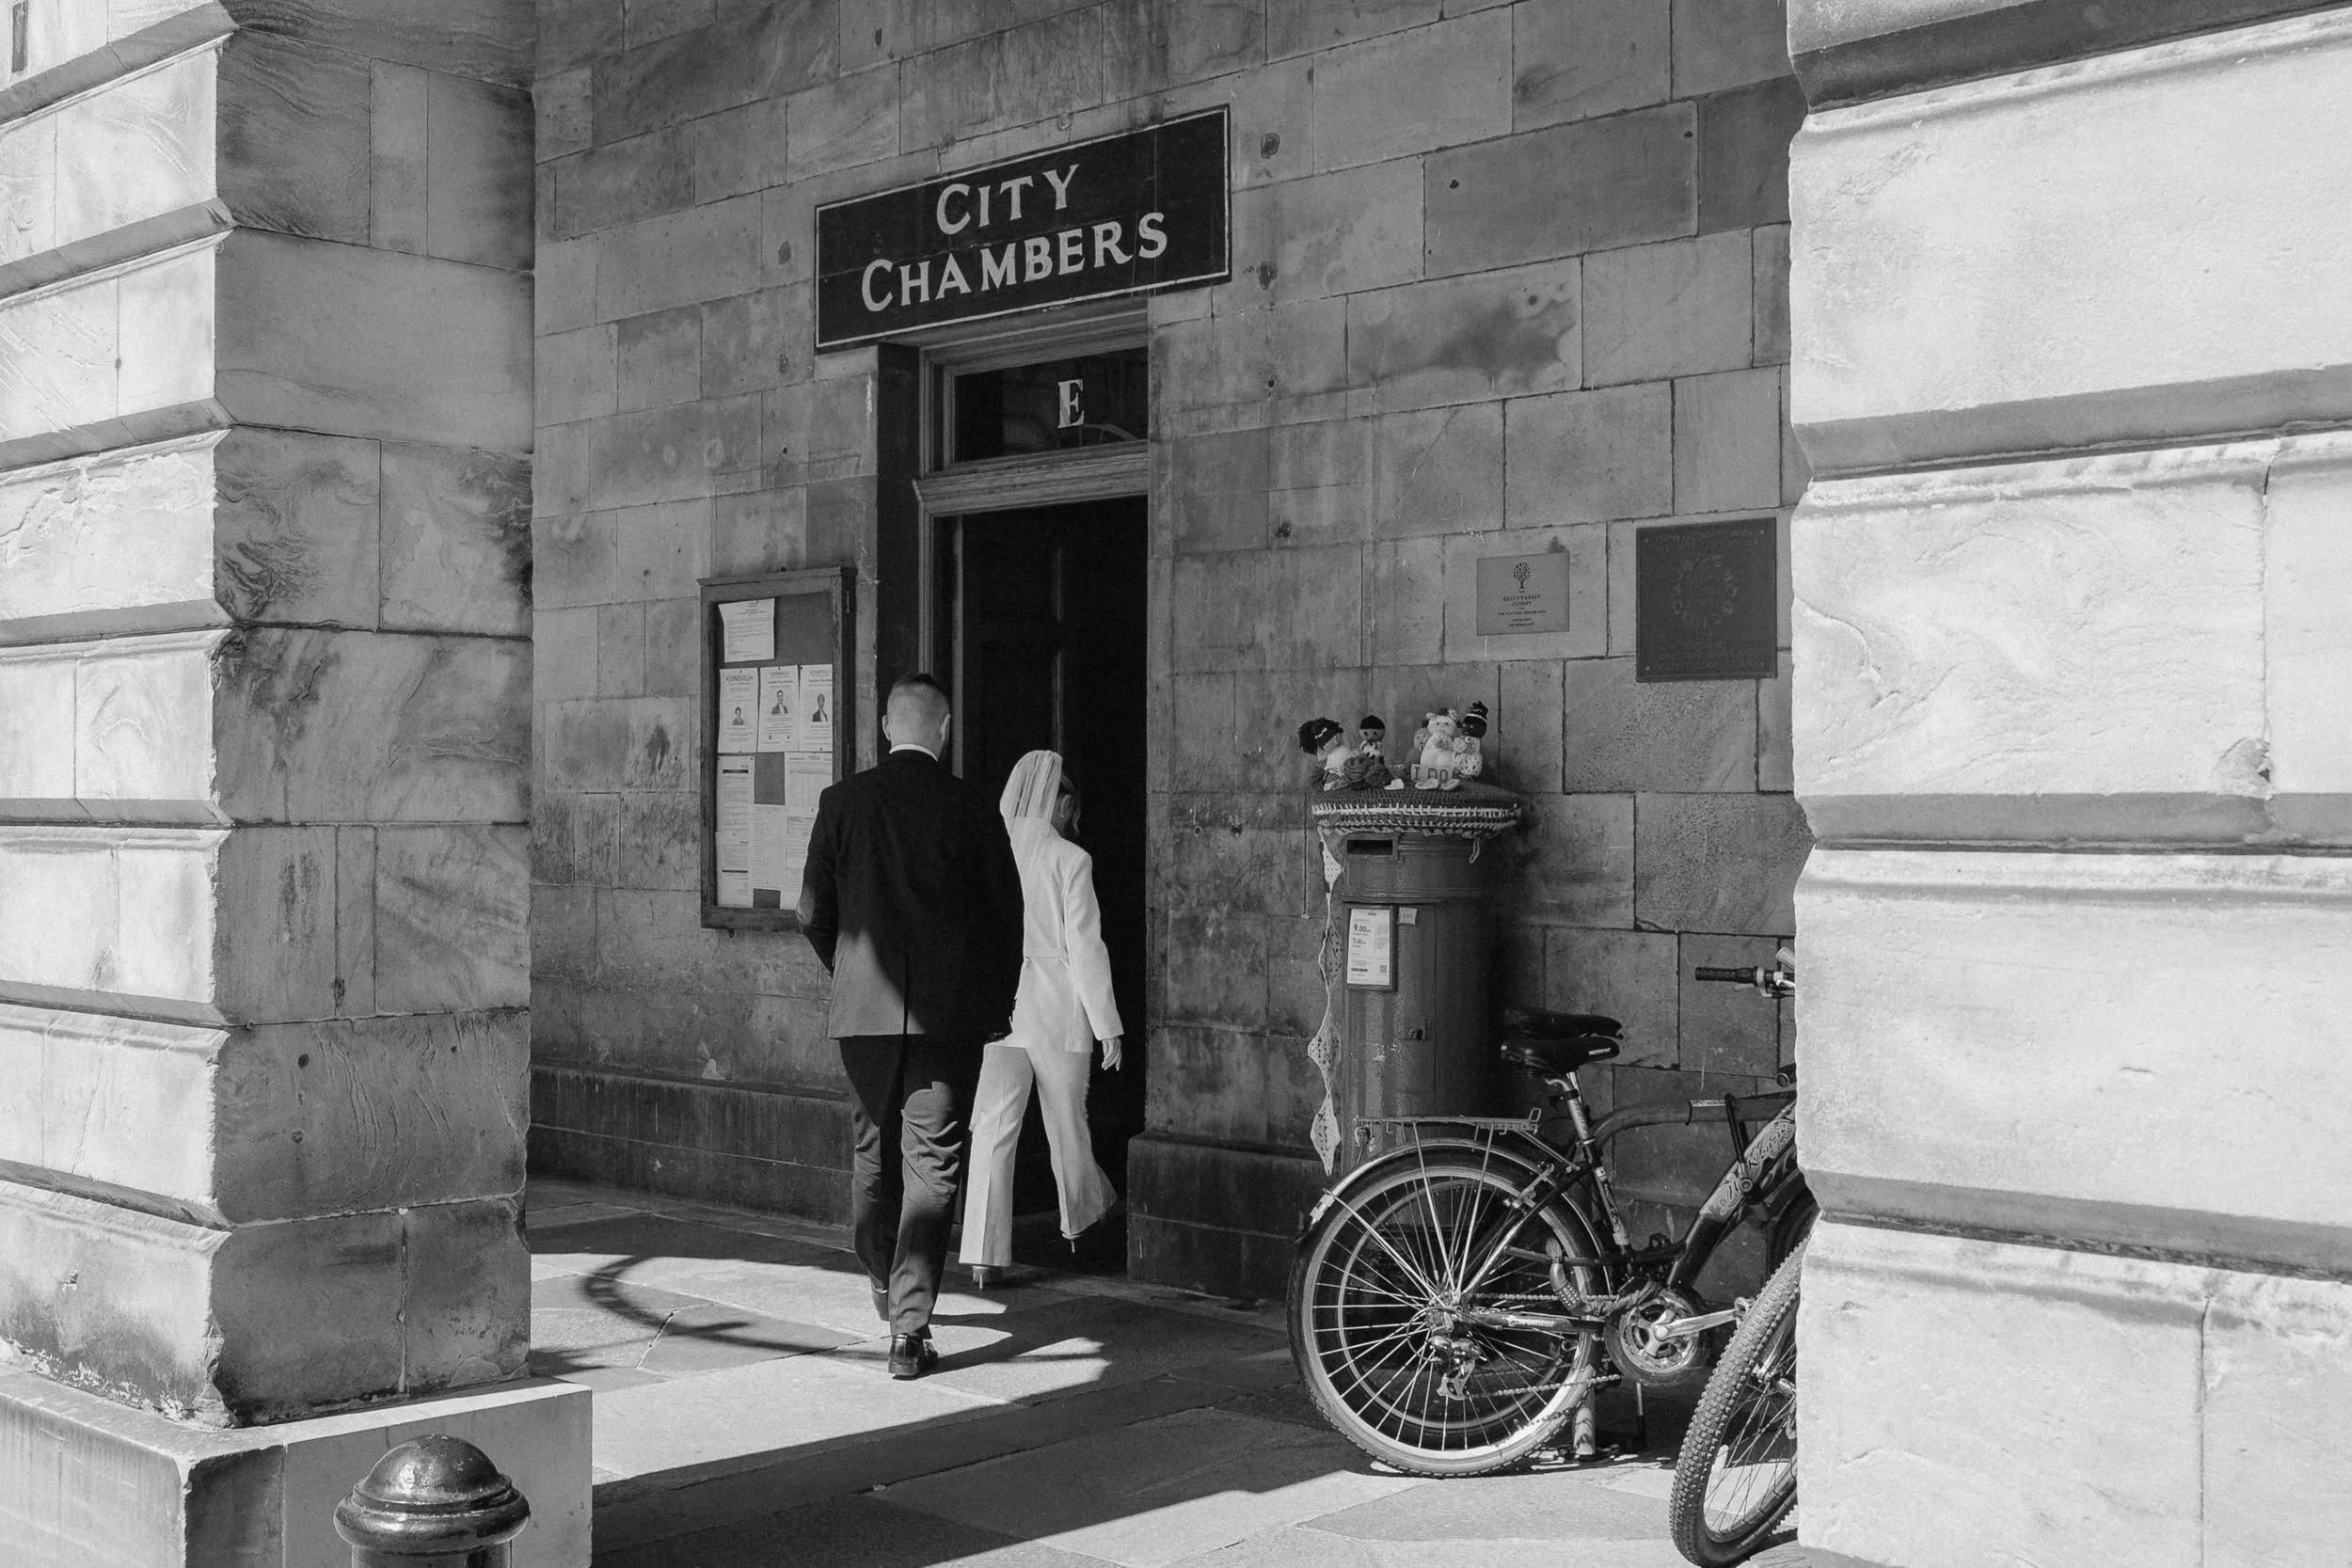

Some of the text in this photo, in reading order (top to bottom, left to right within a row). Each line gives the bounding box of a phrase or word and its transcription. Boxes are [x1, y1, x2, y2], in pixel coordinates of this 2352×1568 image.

[936, 164, 1081, 235] CITY
[861, 212, 1168, 312] CHAMBERS
[1057, 378, 1085, 429] E
[1413, 766, 1449, 783] I DO
